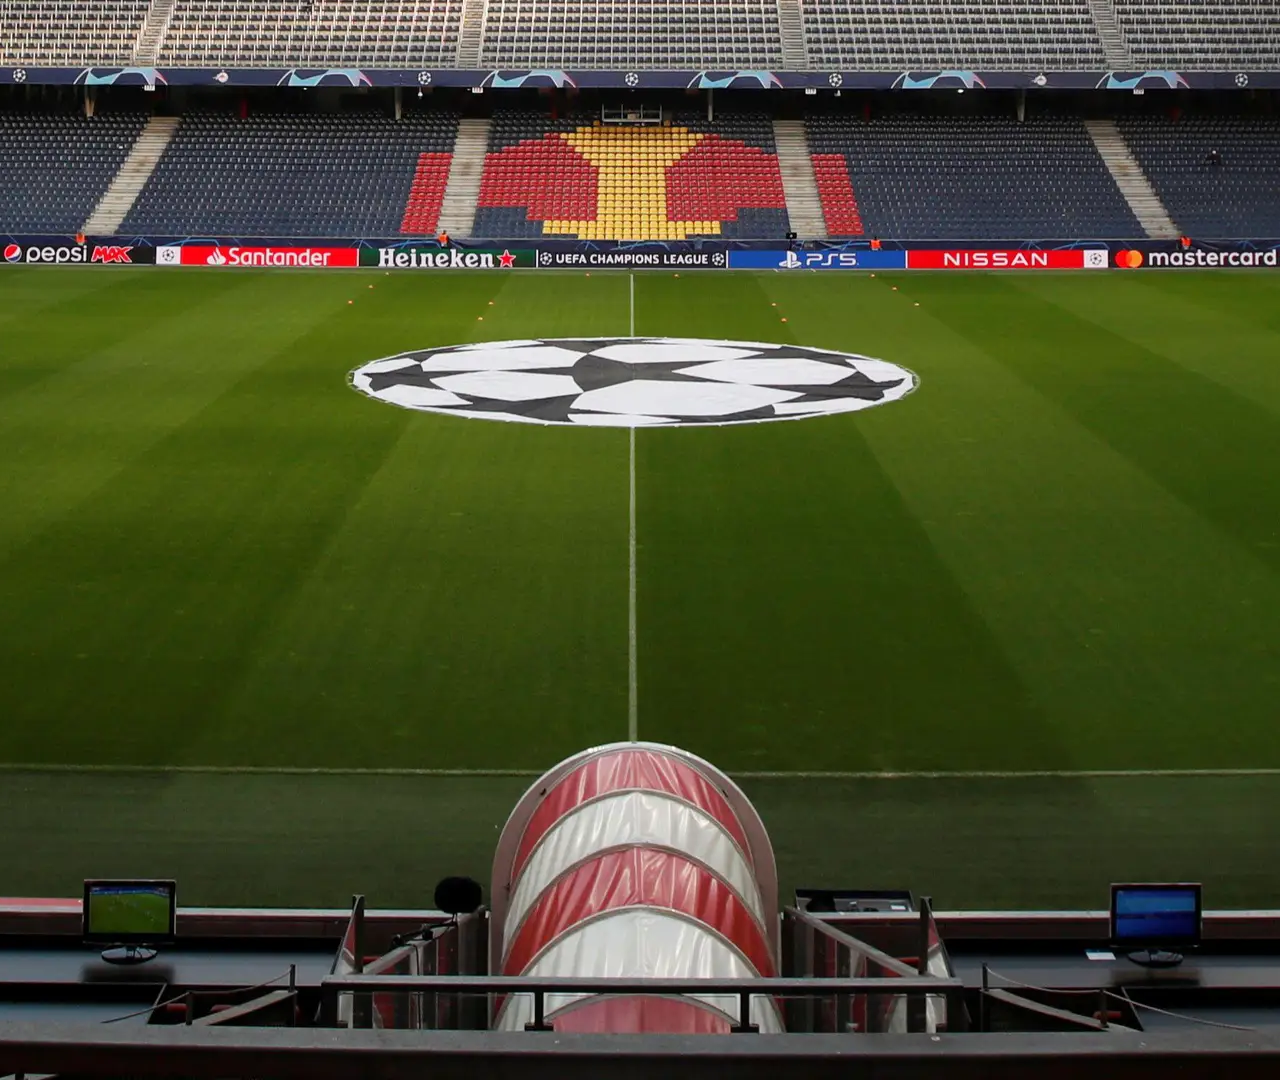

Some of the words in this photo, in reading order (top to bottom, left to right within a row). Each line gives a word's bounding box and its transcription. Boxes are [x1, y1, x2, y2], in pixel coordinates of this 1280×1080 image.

[26, 243, 88, 263] pepsi
[91, 246, 133, 263] MAX
[229, 247, 331, 266] Santander
[379, 248, 494, 267] Heineken
[555, 253, 586, 264] UEFA
[590, 253, 659, 265] CHAMPIONS
[663, 254, 709, 265] LEAGUE
[806, 253, 858, 266] PS5
[943, 253, 1048, 266] NISSAN
[1148, 248, 1277, 266] mastercard
